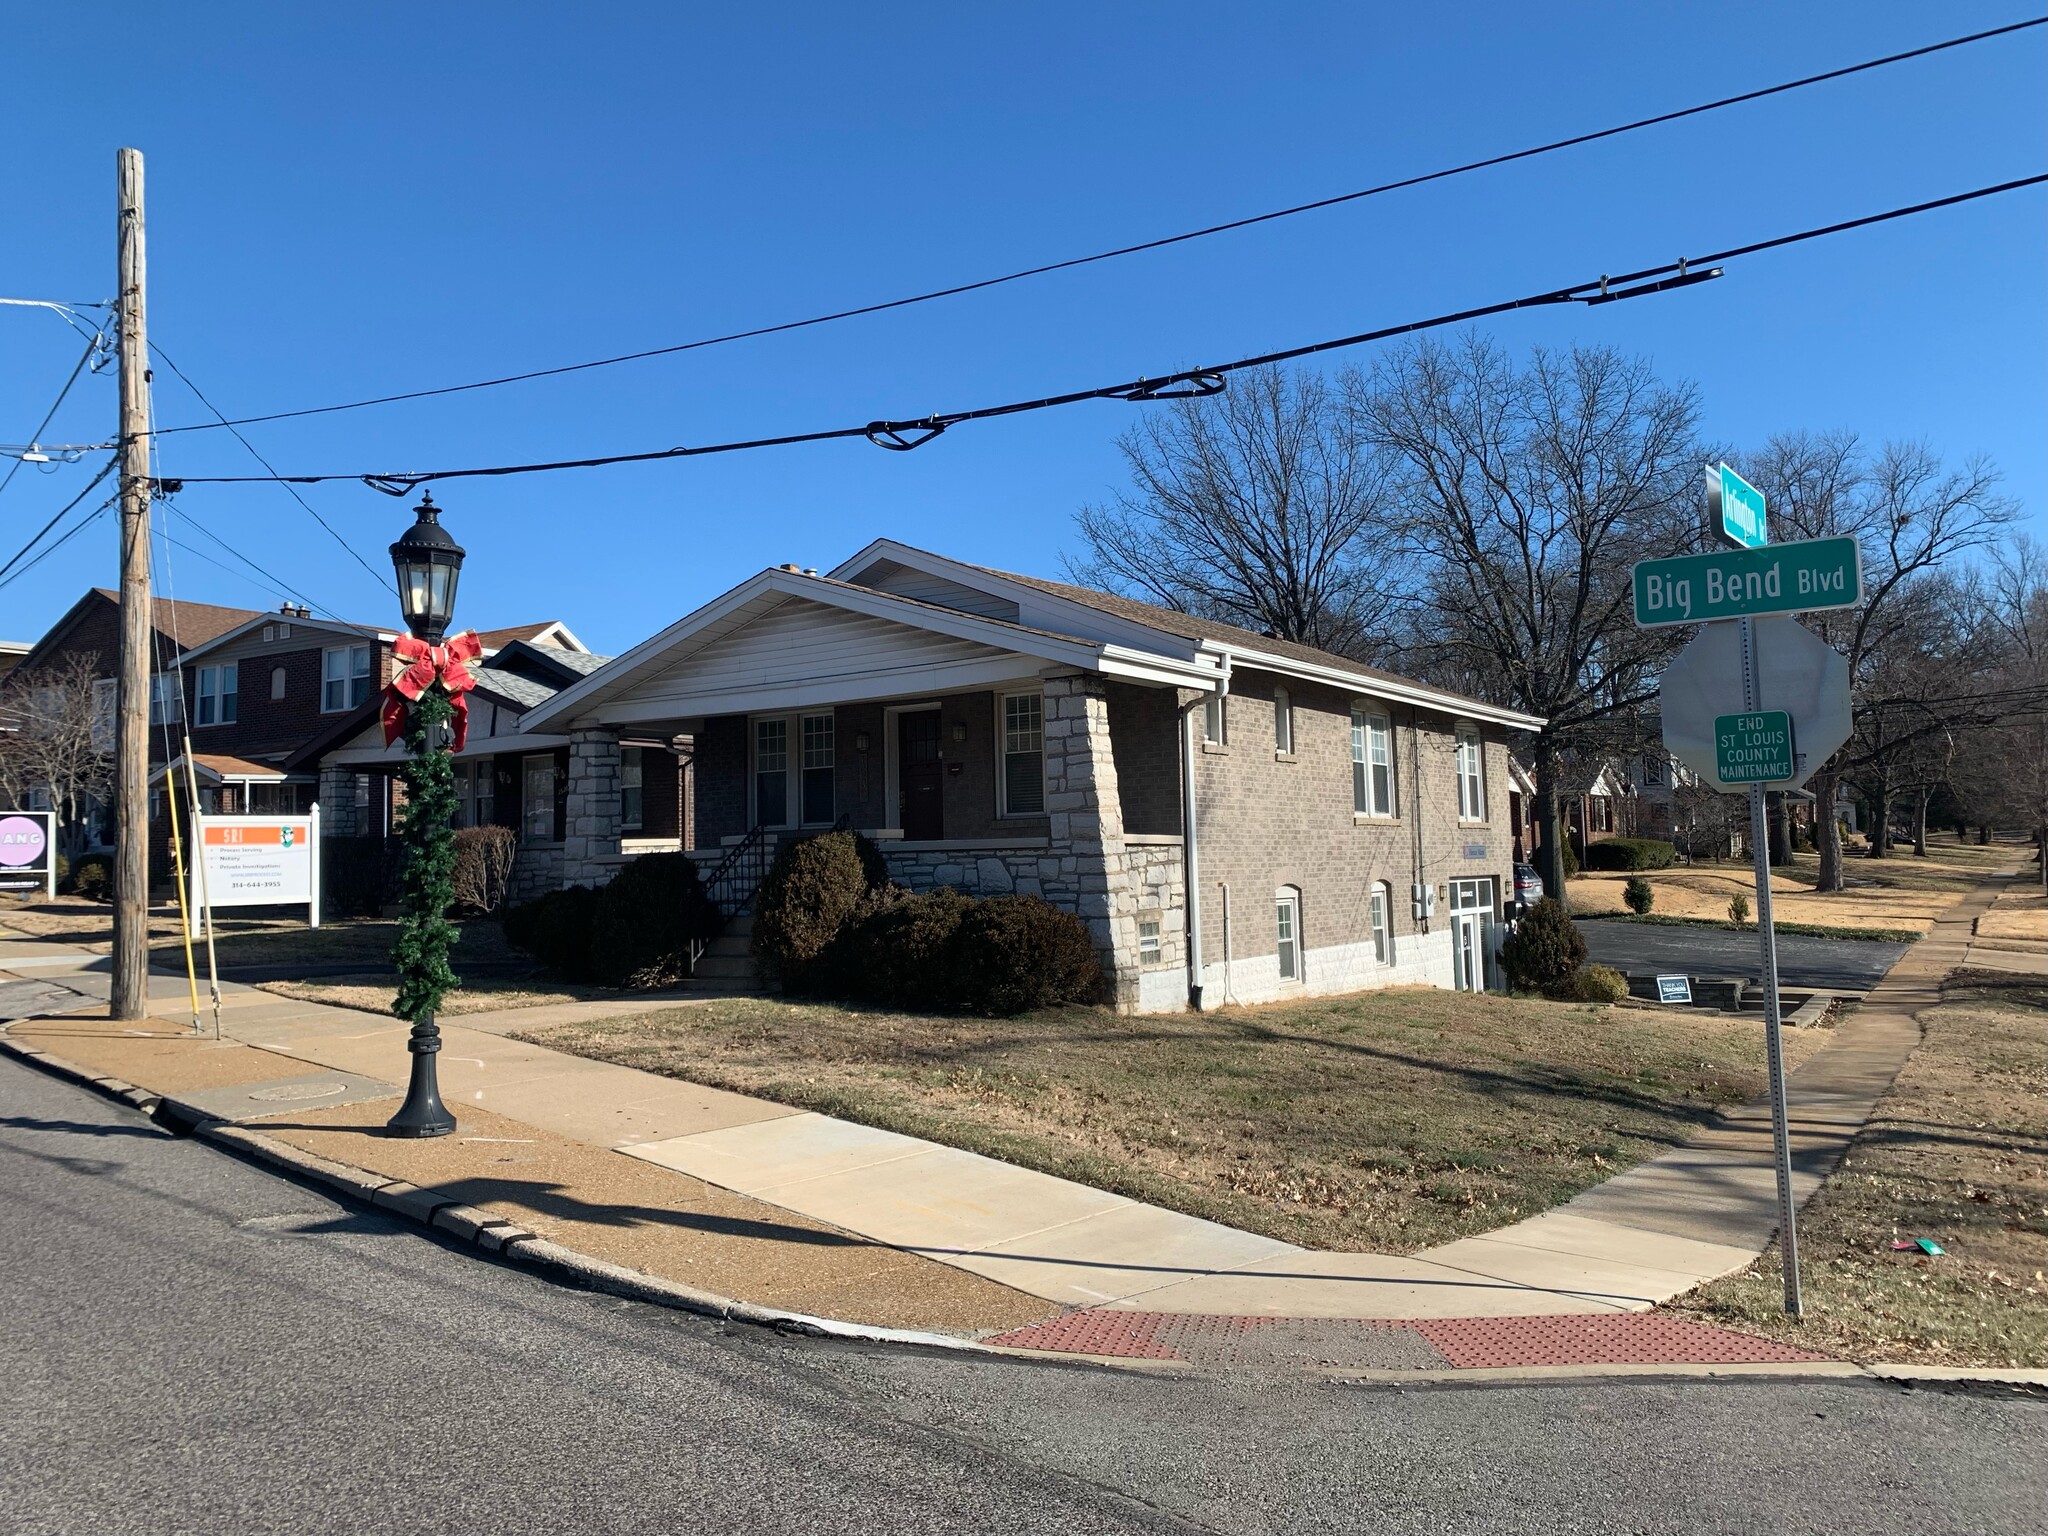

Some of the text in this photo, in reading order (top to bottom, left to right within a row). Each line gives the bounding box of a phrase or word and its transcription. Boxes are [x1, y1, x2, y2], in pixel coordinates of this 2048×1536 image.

[1647, 561, 1844, 619] Big Bend Blvd
[1737, 717, 1764, 731] END
[1721, 731, 1784, 748] ST LOUIS
[1727, 747, 1779, 763] COUNTY
[1720, 762, 1790, 779] MAINTENANCE
[223, 828, 244, 844] SRI
